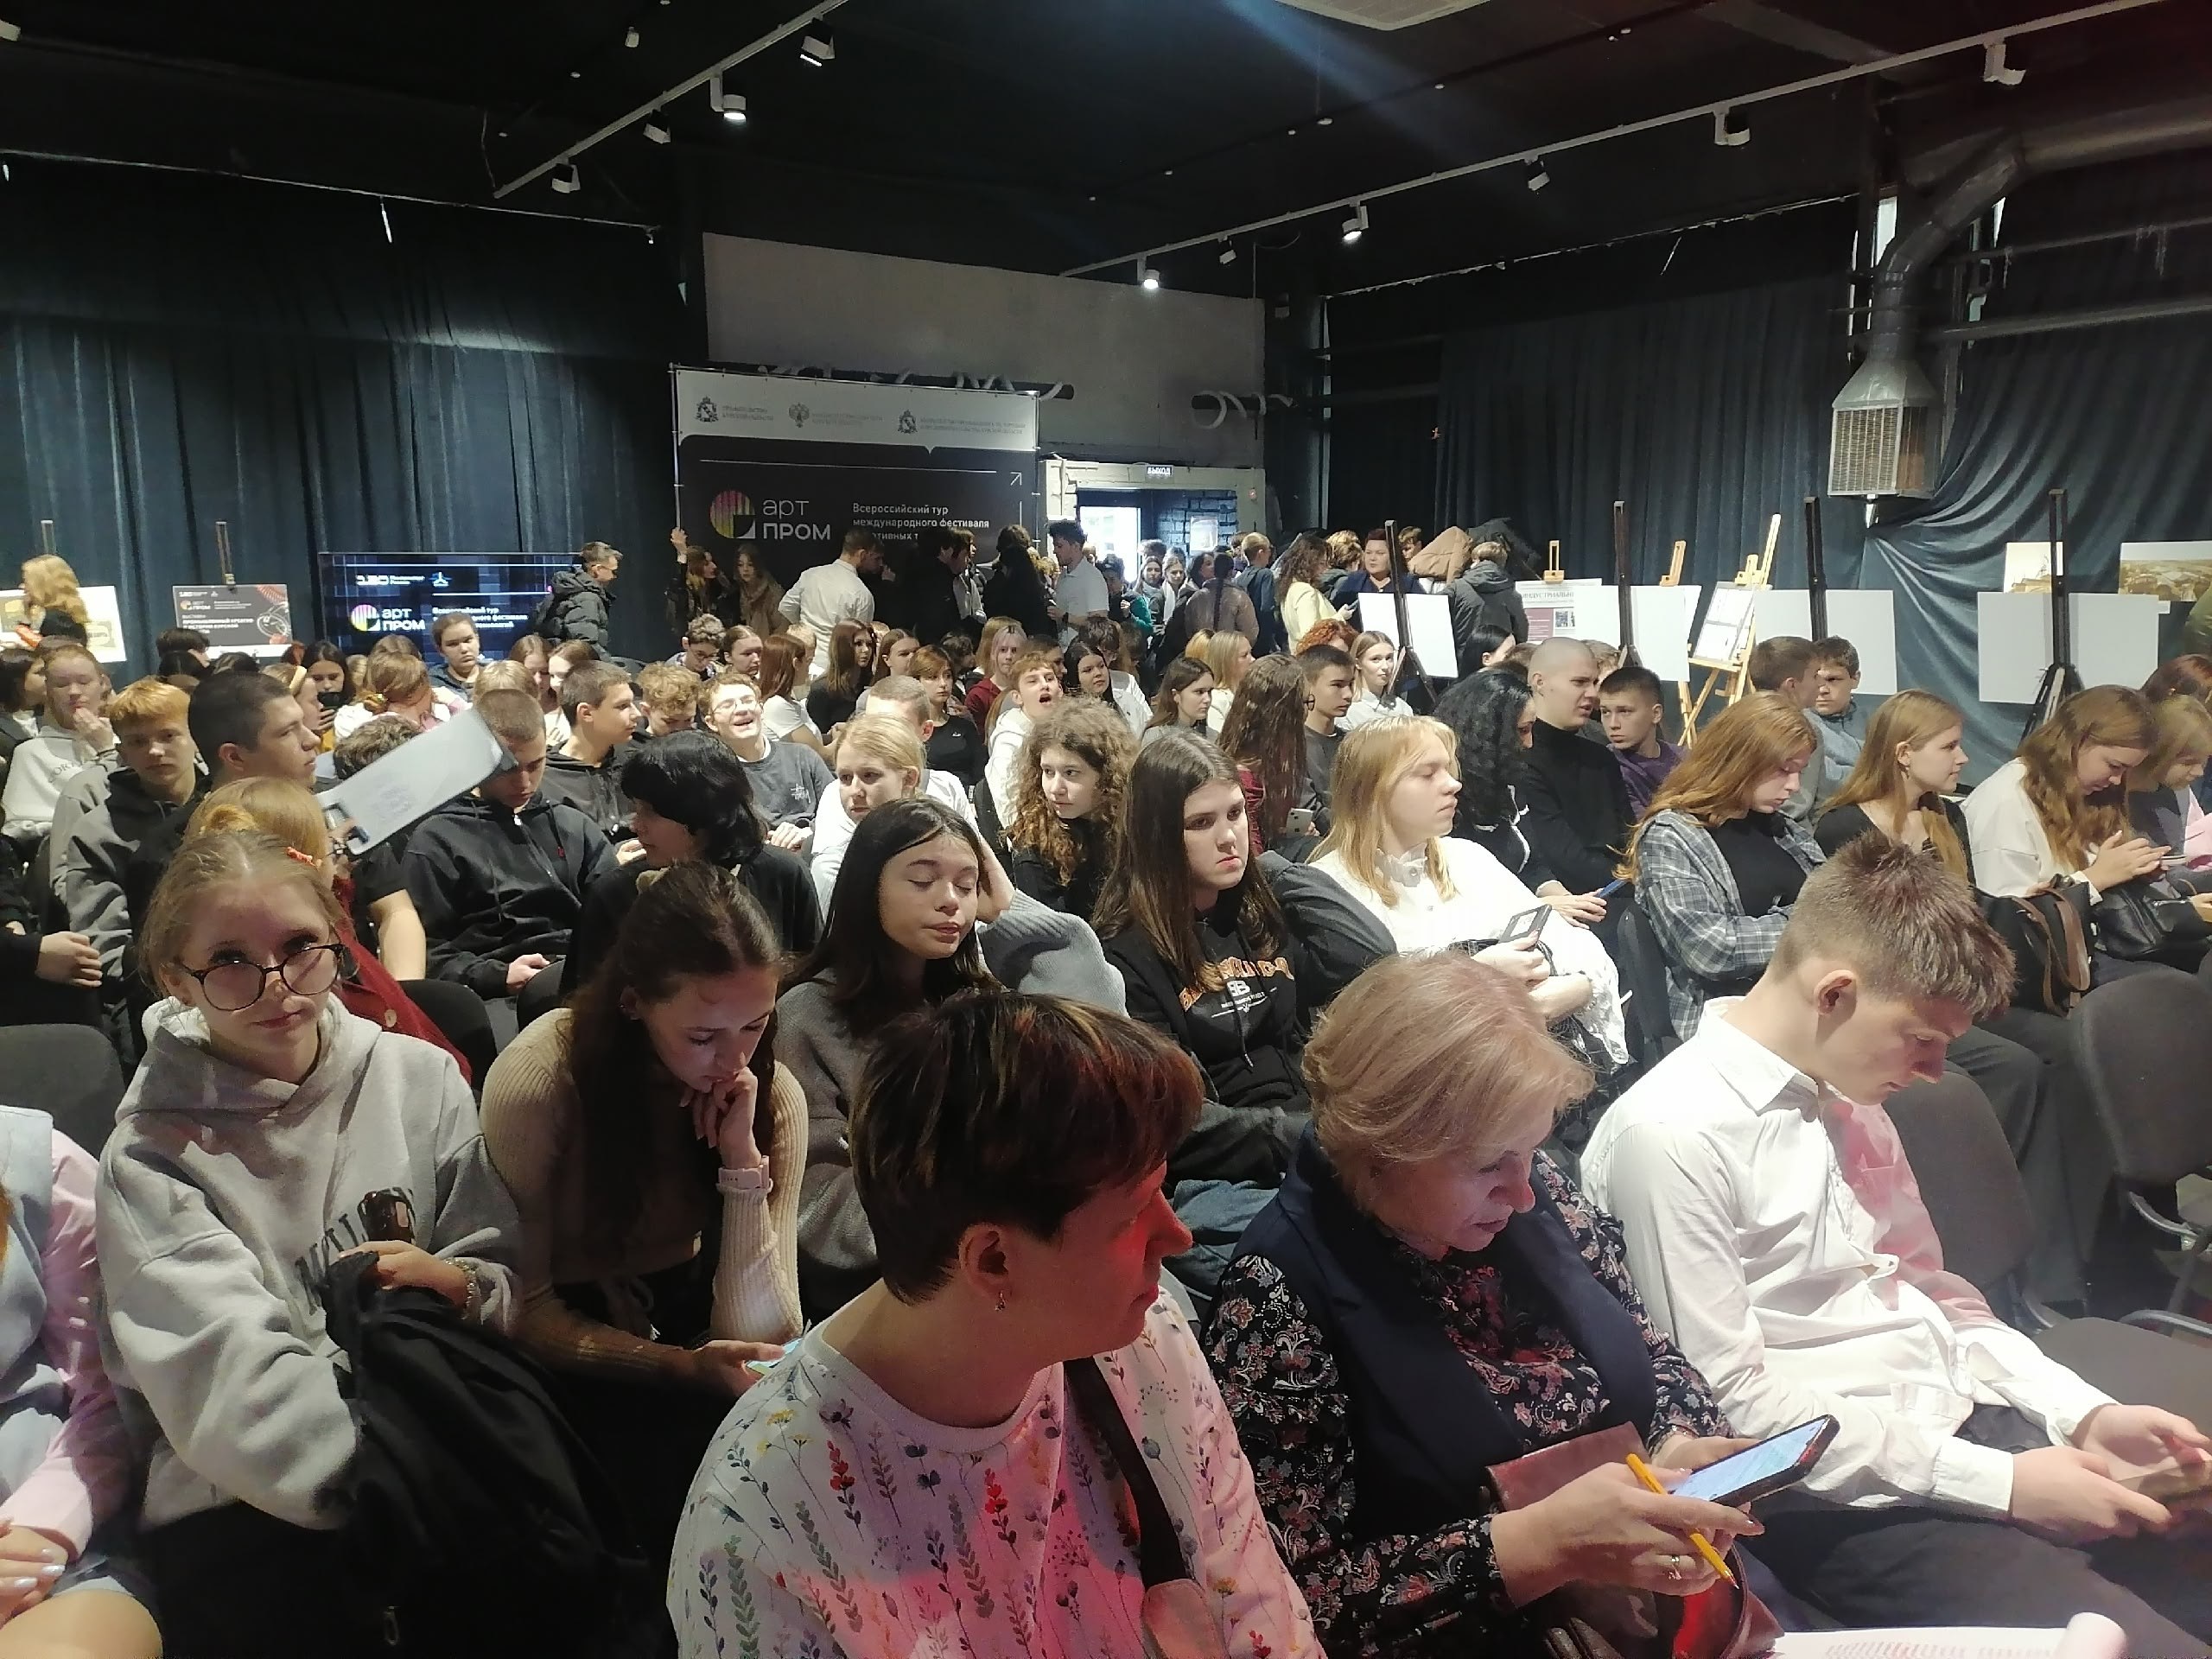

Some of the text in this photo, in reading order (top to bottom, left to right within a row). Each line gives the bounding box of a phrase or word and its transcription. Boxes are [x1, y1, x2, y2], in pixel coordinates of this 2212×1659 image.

[1147, 467, 1171, 476] ВЫХОД
[763, 499, 810, 520] арт
[853, 502, 949, 516] Всероссийский тур
[853, 518, 990, 529] международного фестиваля
[763, 522, 831, 541] ПРОМ
[382, 607, 413, 620] арт
[383, 620, 426, 631] ПРОМ
